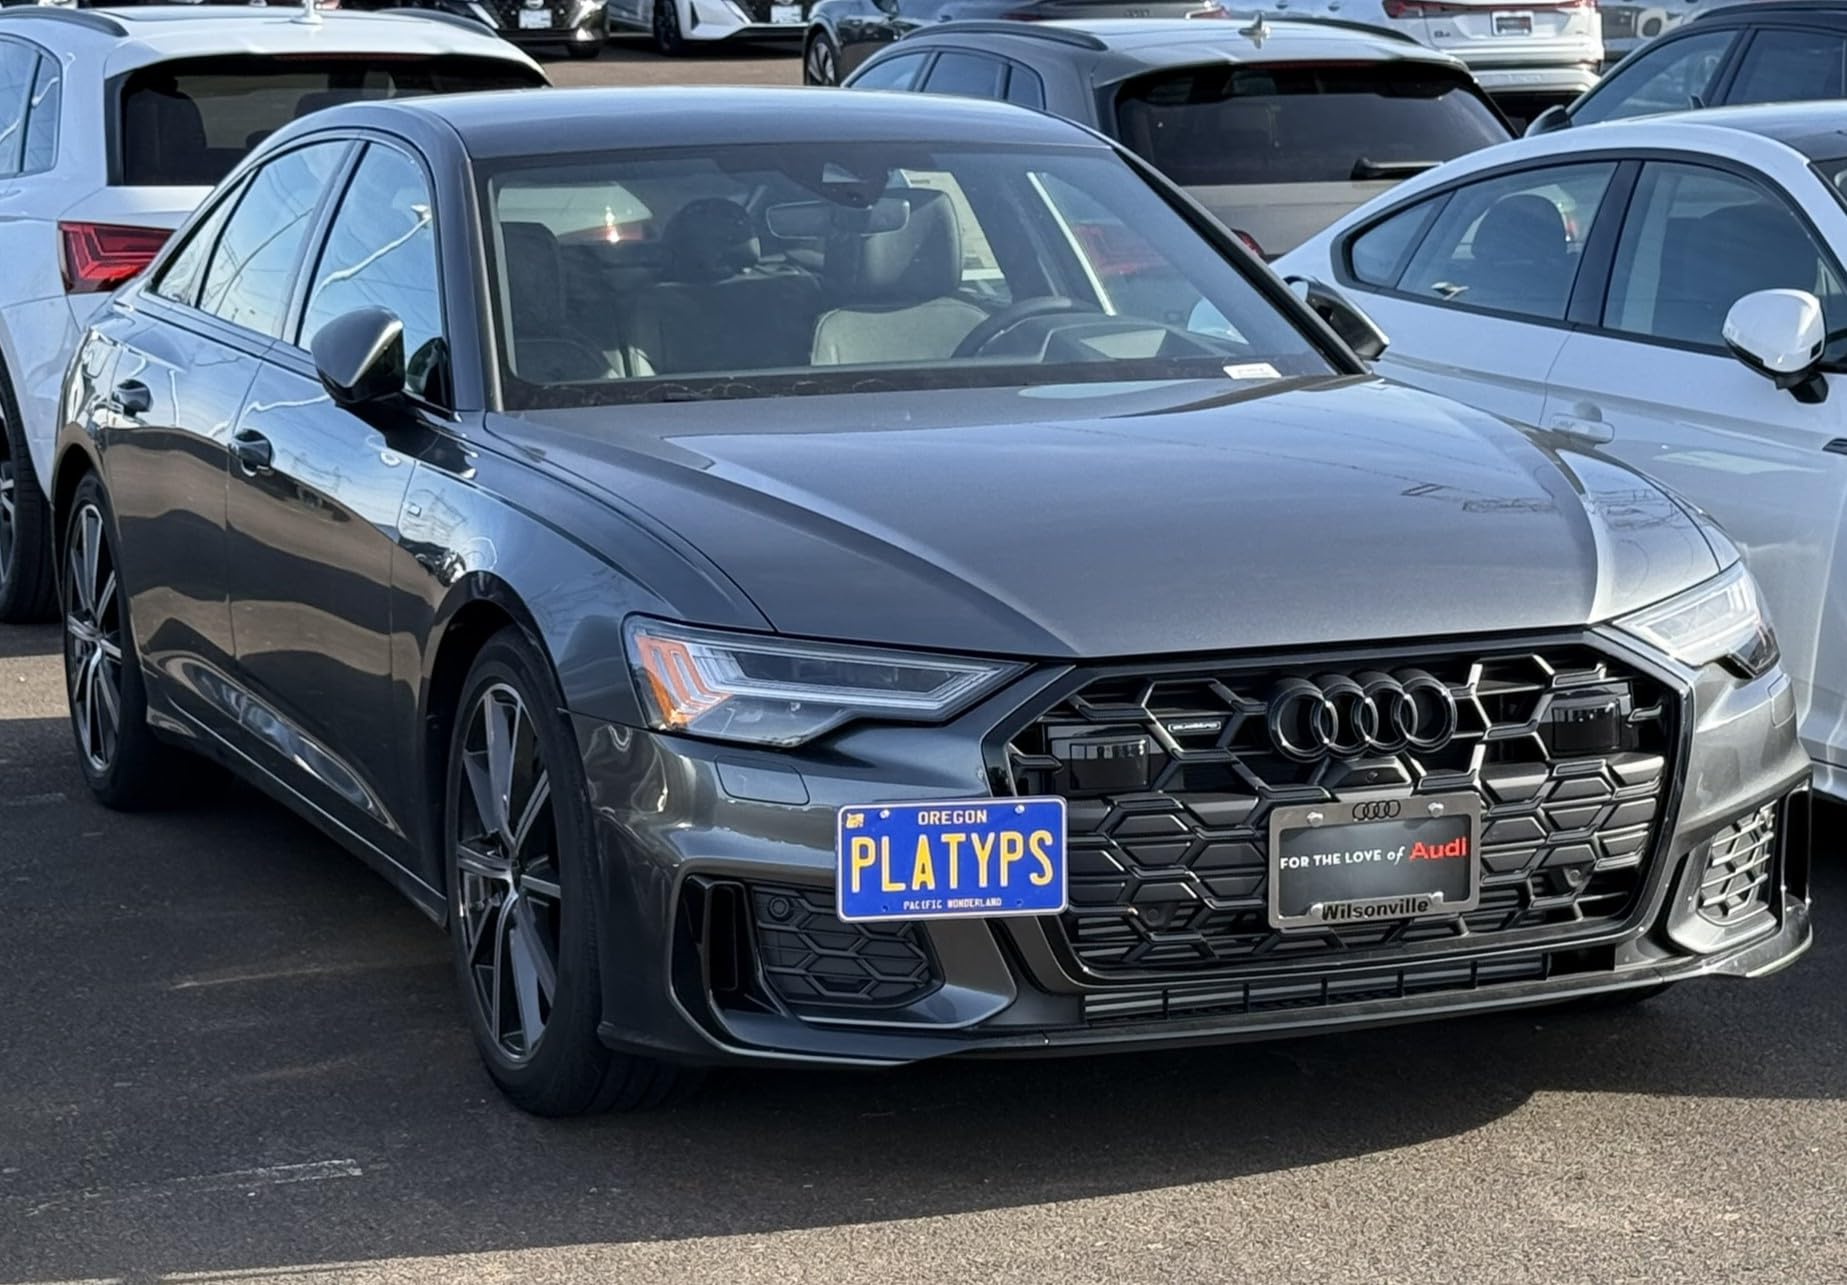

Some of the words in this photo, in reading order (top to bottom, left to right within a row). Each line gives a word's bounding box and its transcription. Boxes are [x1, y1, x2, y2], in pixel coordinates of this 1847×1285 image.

[918, 810, 988, 826] OREGON
[851, 830, 1054, 893] PLATYPS
[1280, 856, 1309, 869] FOR
[1313, 853, 1341, 866] THE
[1345, 850, 1381, 863] LOVE
[1387, 846, 1405, 866] of
[1409, 836, 1467, 860] Audi
[903, 900, 943, 910] PACIFIC
[1321, 897, 1429, 921] Wilsonville
